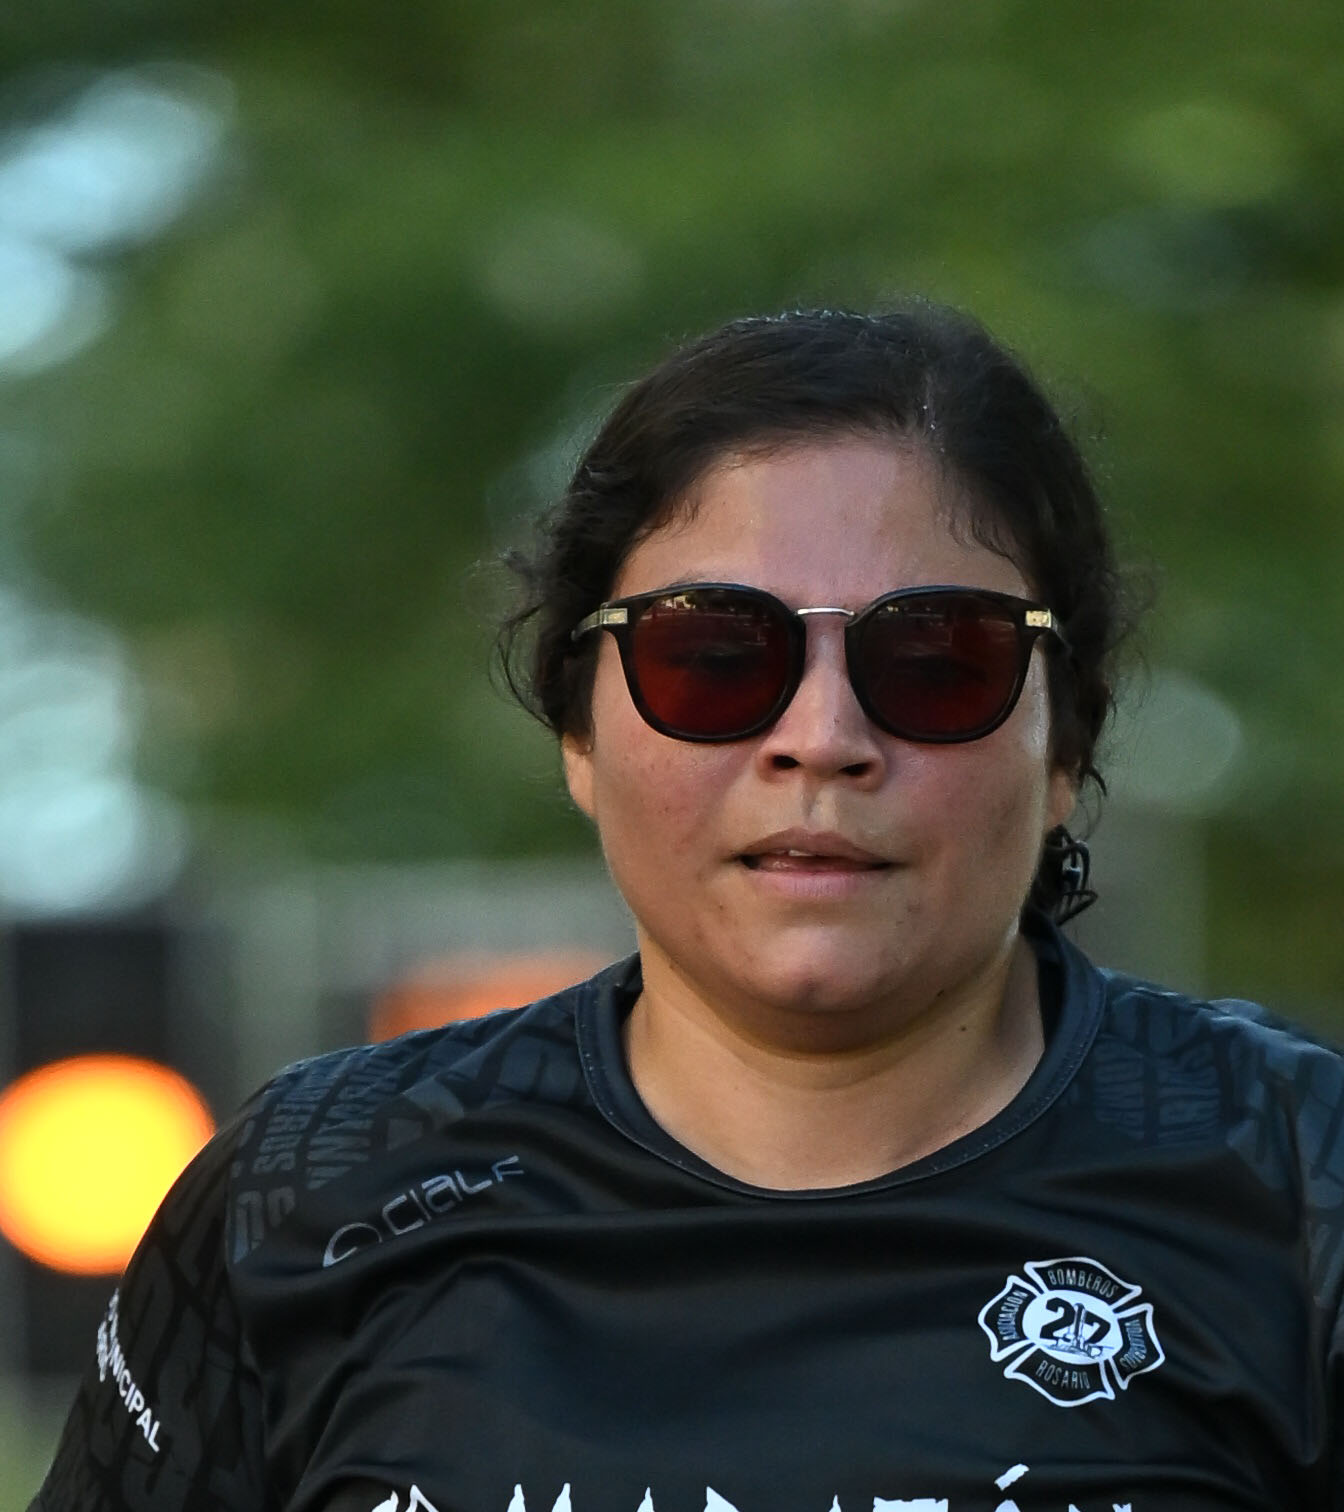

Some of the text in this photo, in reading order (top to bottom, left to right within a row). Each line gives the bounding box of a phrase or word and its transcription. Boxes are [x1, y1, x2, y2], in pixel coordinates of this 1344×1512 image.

[1047, 1268, 1120, 1298] BOMBEROS
[1039, 1296, 1111, 1344] 27
[1035, 1359, 1091, 1389] ROSARIO
